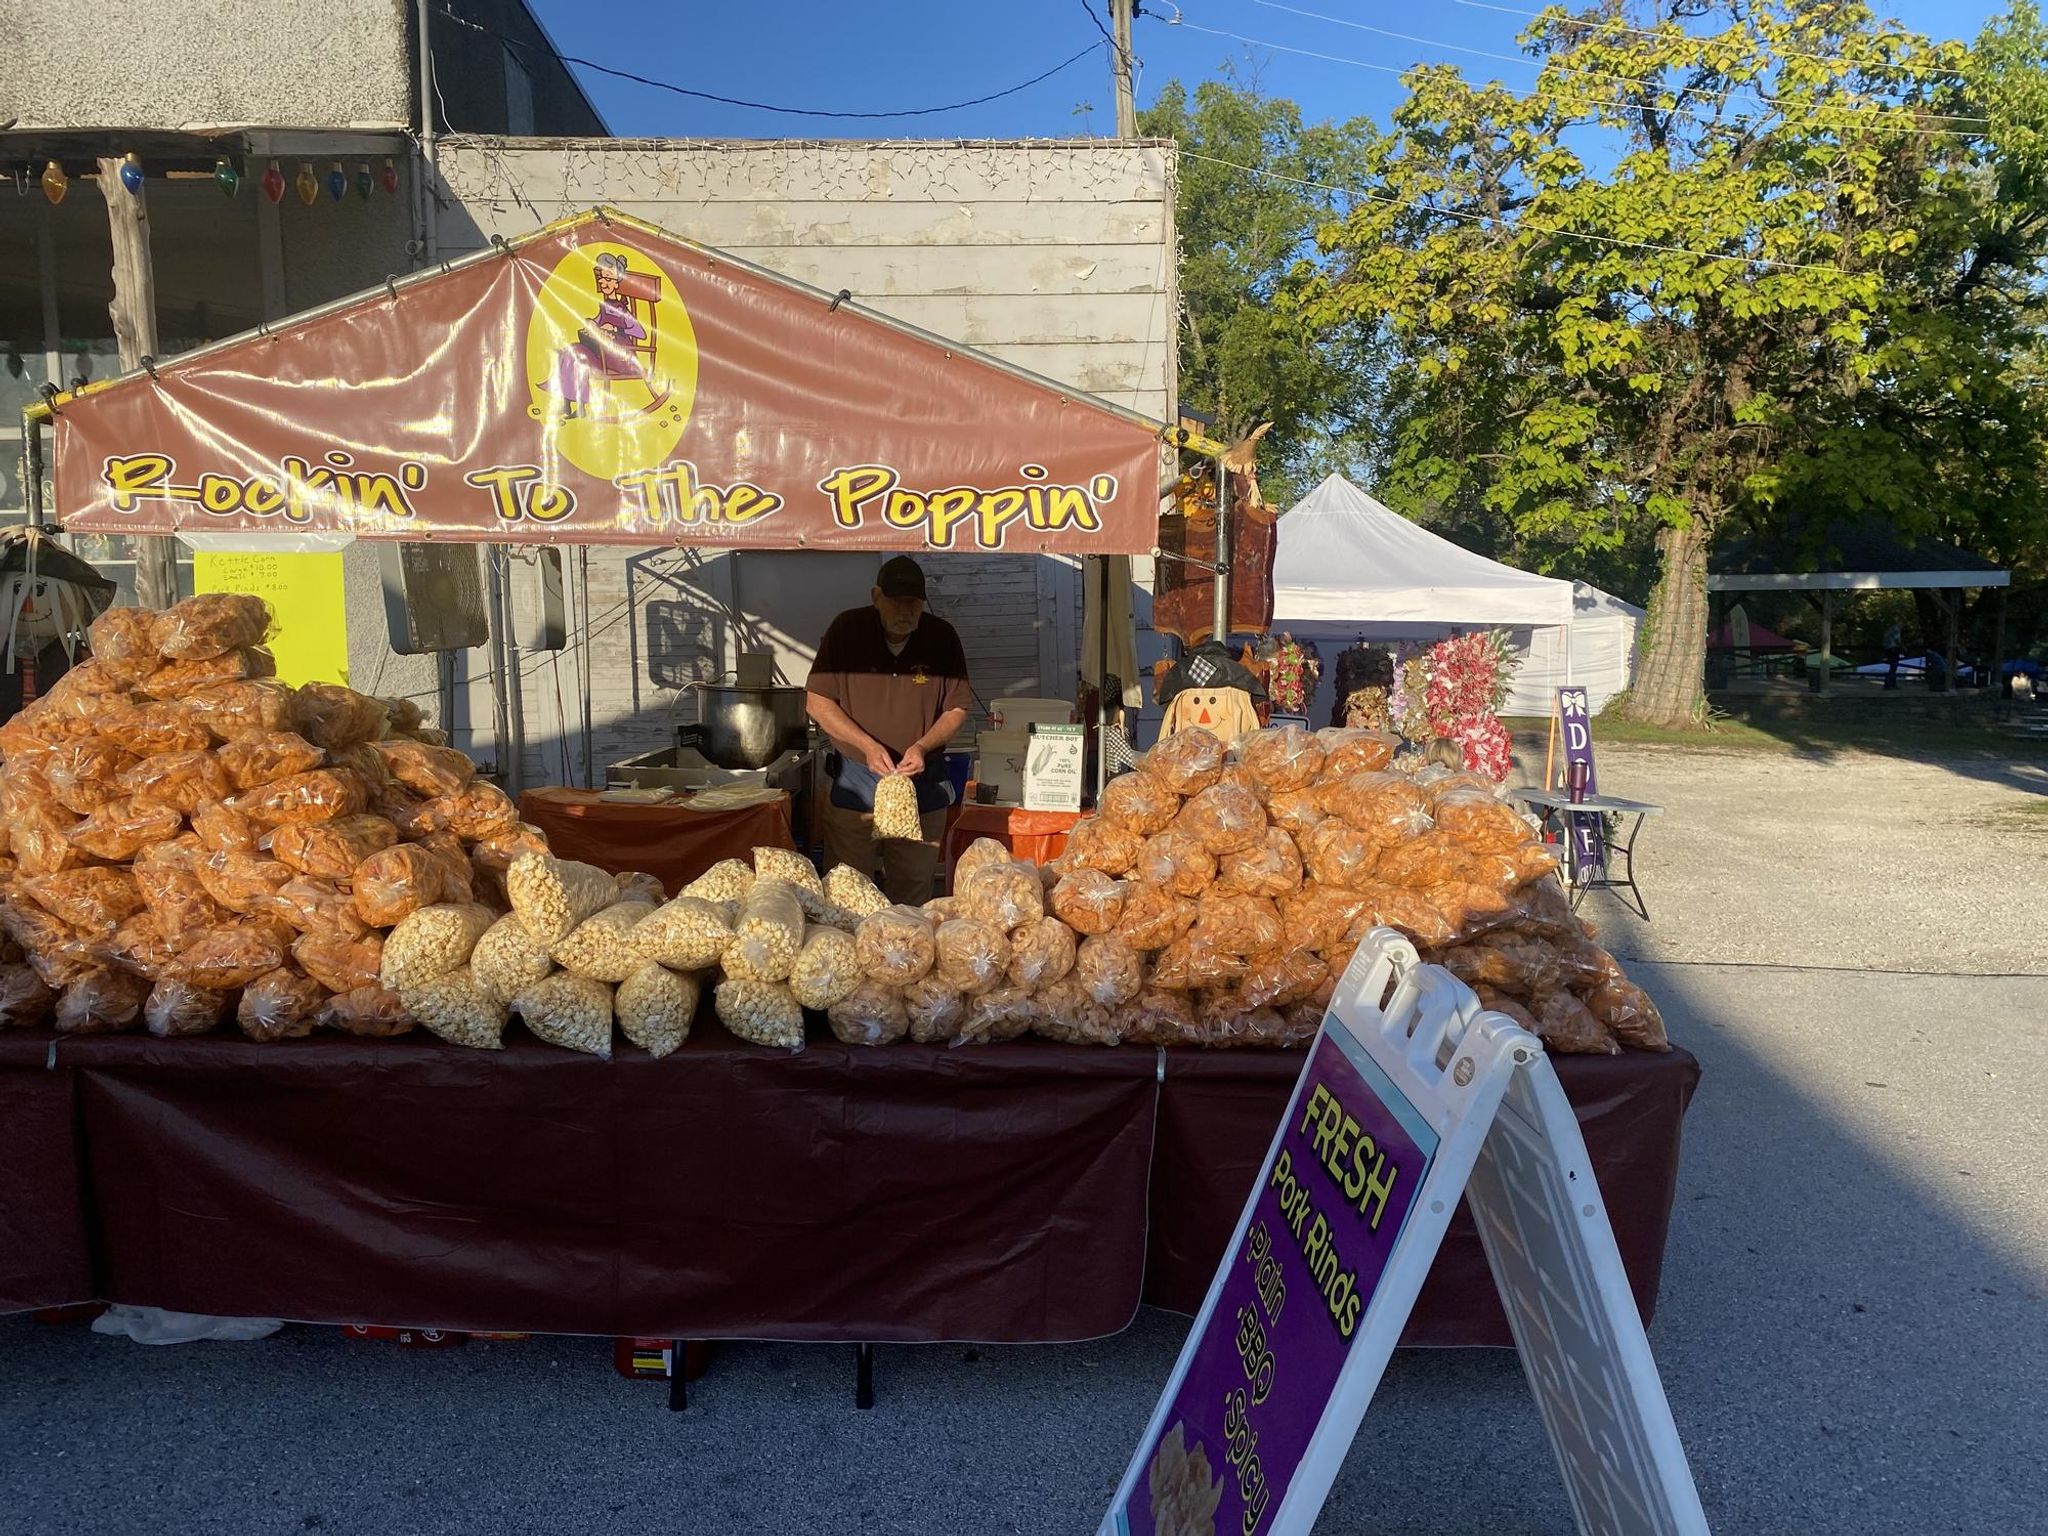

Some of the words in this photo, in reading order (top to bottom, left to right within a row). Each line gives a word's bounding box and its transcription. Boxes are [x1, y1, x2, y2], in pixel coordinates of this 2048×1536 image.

[102, 451, 428, 524] Rockin'
[465, 465, 577, 523] To
[611, 460, 783, 525] The
[818, 464, 1119, 549] Poppin'
[209, 553, 249, 567] Kettle
[1301, 1082, 1397, 1229] FRESH
[1271, 1149, 1310, 1239] Pork
[1304, 1213, 1361, 1337] Rinds
